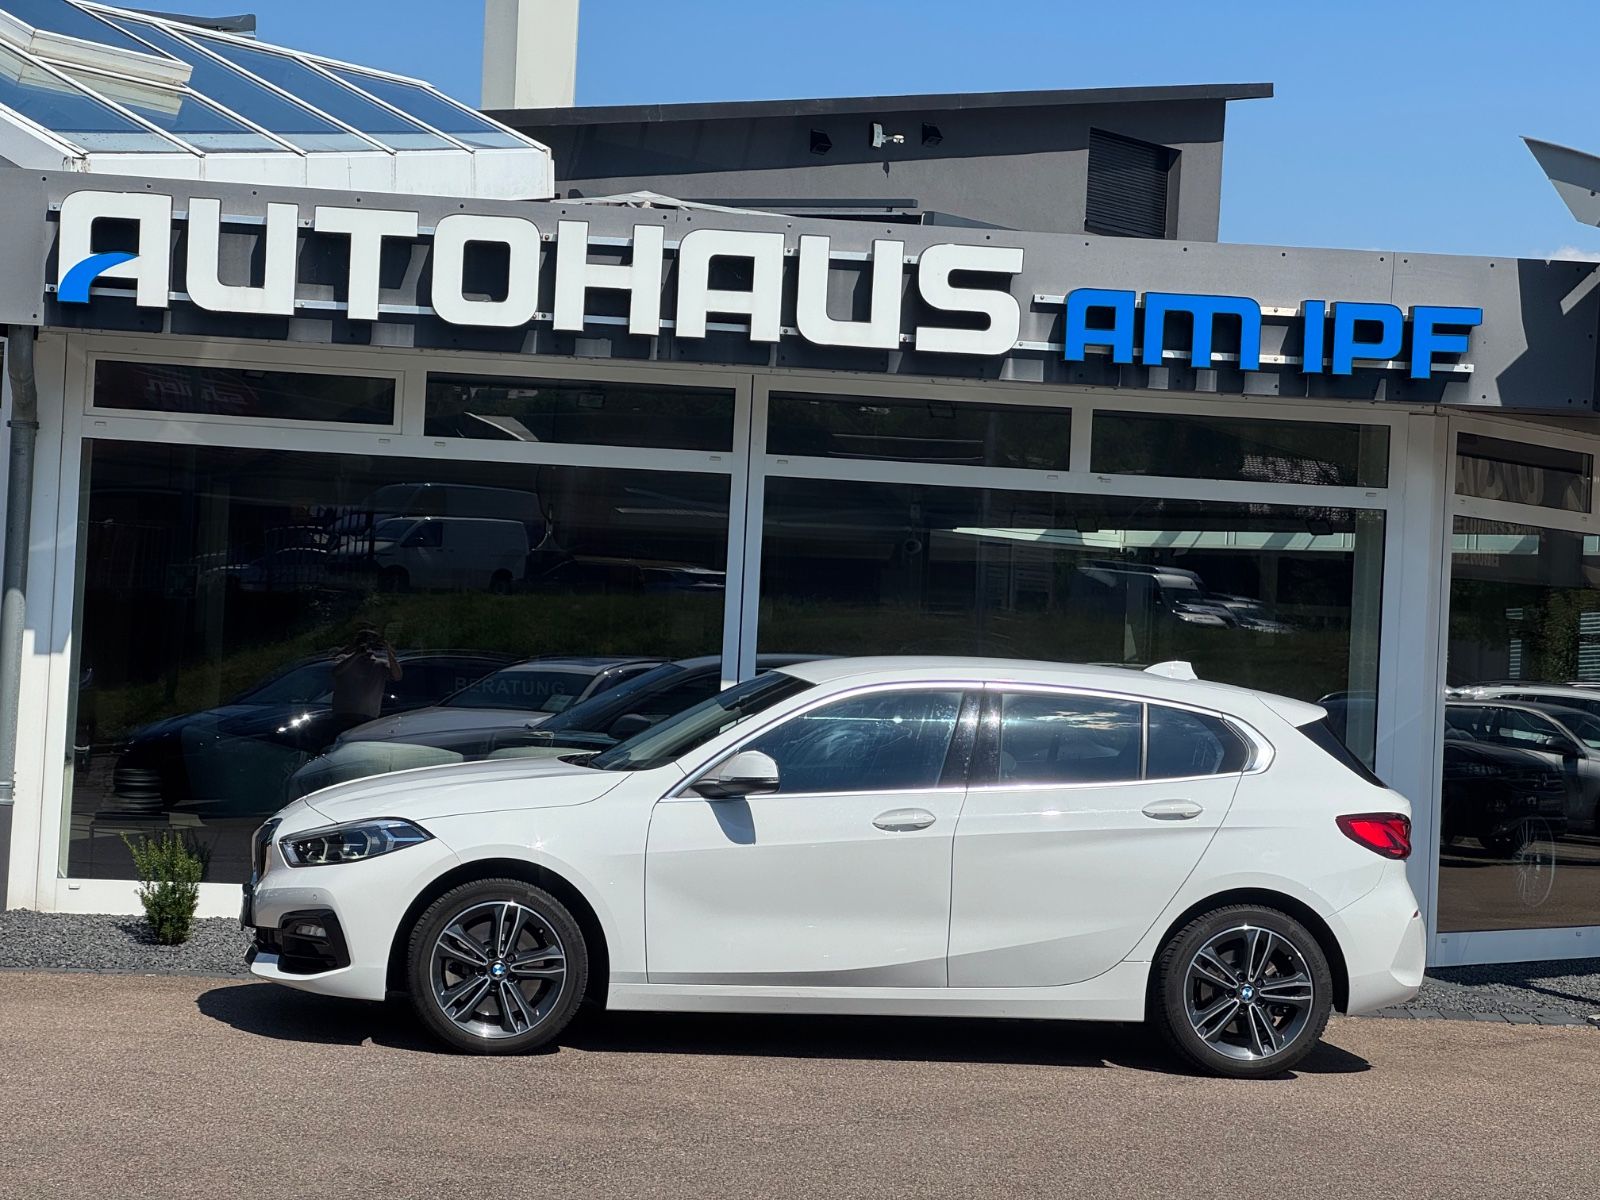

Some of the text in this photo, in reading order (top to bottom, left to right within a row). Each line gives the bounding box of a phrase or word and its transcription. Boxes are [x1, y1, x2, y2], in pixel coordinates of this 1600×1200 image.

[57, 190, 1484, 380] AUTOHAUS AM IPF
[455, 676, 566, 697] BERATUNG
